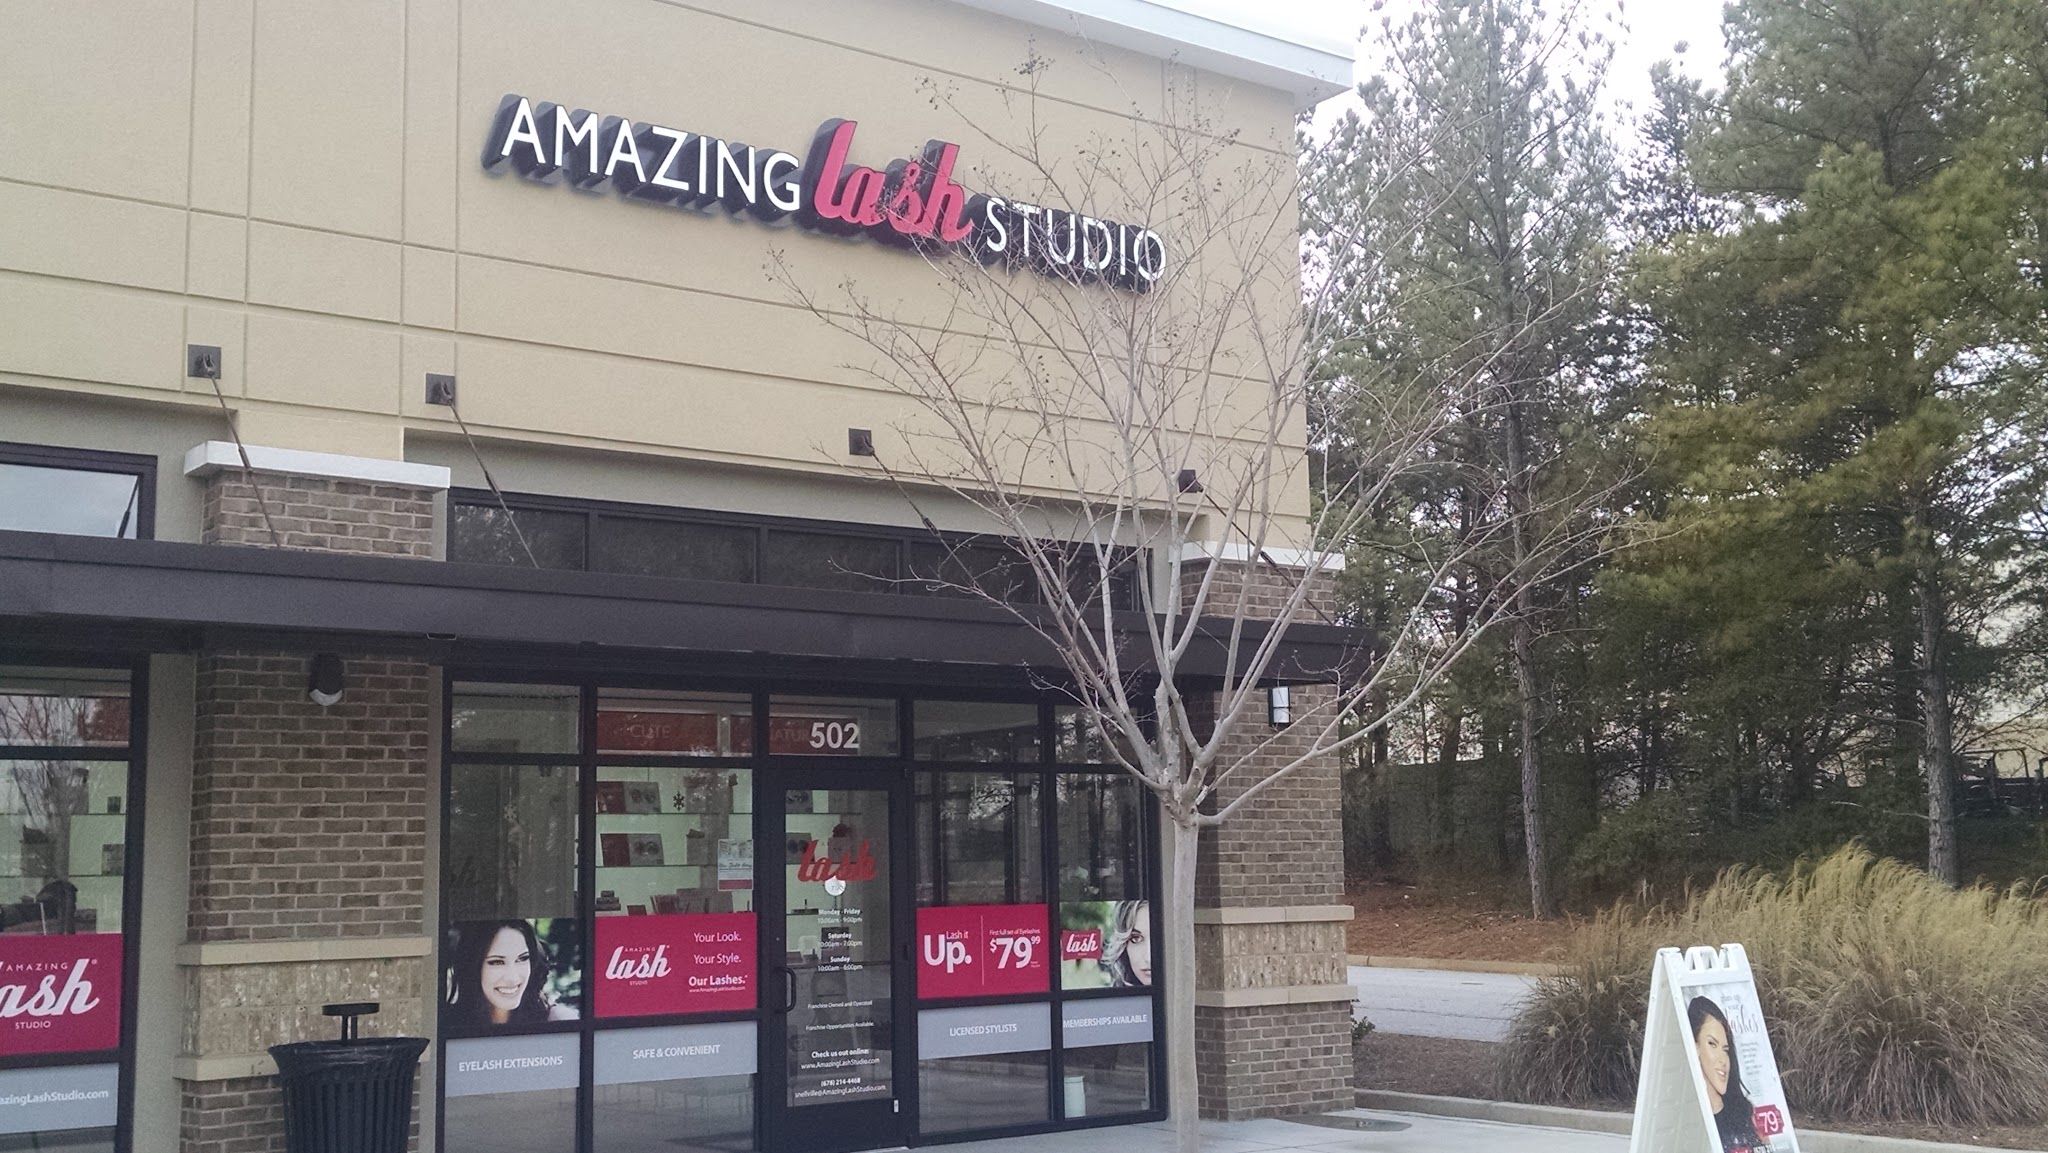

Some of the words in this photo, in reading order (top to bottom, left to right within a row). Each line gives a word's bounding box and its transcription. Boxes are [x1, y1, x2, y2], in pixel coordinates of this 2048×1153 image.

[502, 97, 799, 212] AMAZING
[813, 120, 973, 243] lash
[985, 196, 1168, 281] STUDIO
[809, 722, 860, 749] 502
[844, 908, 861, 916] Friday
[694, 932, 715, 942] Your
[717, 931, 742, 942] Look.
[946, 930, 963, 940] Lash
[963, 930, 969, 939] it
[1066, 933, 1098, 952] lash
[694, 954, 715, 964] Your
[717, 952, 742, 965] Style.
[924, 934, 972, 973] Up.
[6, 961, 69, 972] AMAZING
[605, 944, 672, 979] lash
[688, 976, 708, 986] Our
[15, 1020, 52, 1030] STUDIO
[1063, 1016, 1112, 1029] MEMBERSHIPS
[1112, 1014, 1148, 1025] AVAILABLE
[950, 1025, 985, 1037] LICENSED
[985, 1023, 1017, 1035] STYLISTS
[633, 1048, 655, 1059] SAFE
[656, 1048, 664, 1058] &
[664, 1044, 721, 1057] CONVENIENT
[811, 1050, 830, 1059] Check
[459, 1059, 502, 1072] EYELASH
[503, 1055, 563, 1069] EXTENSIONS
